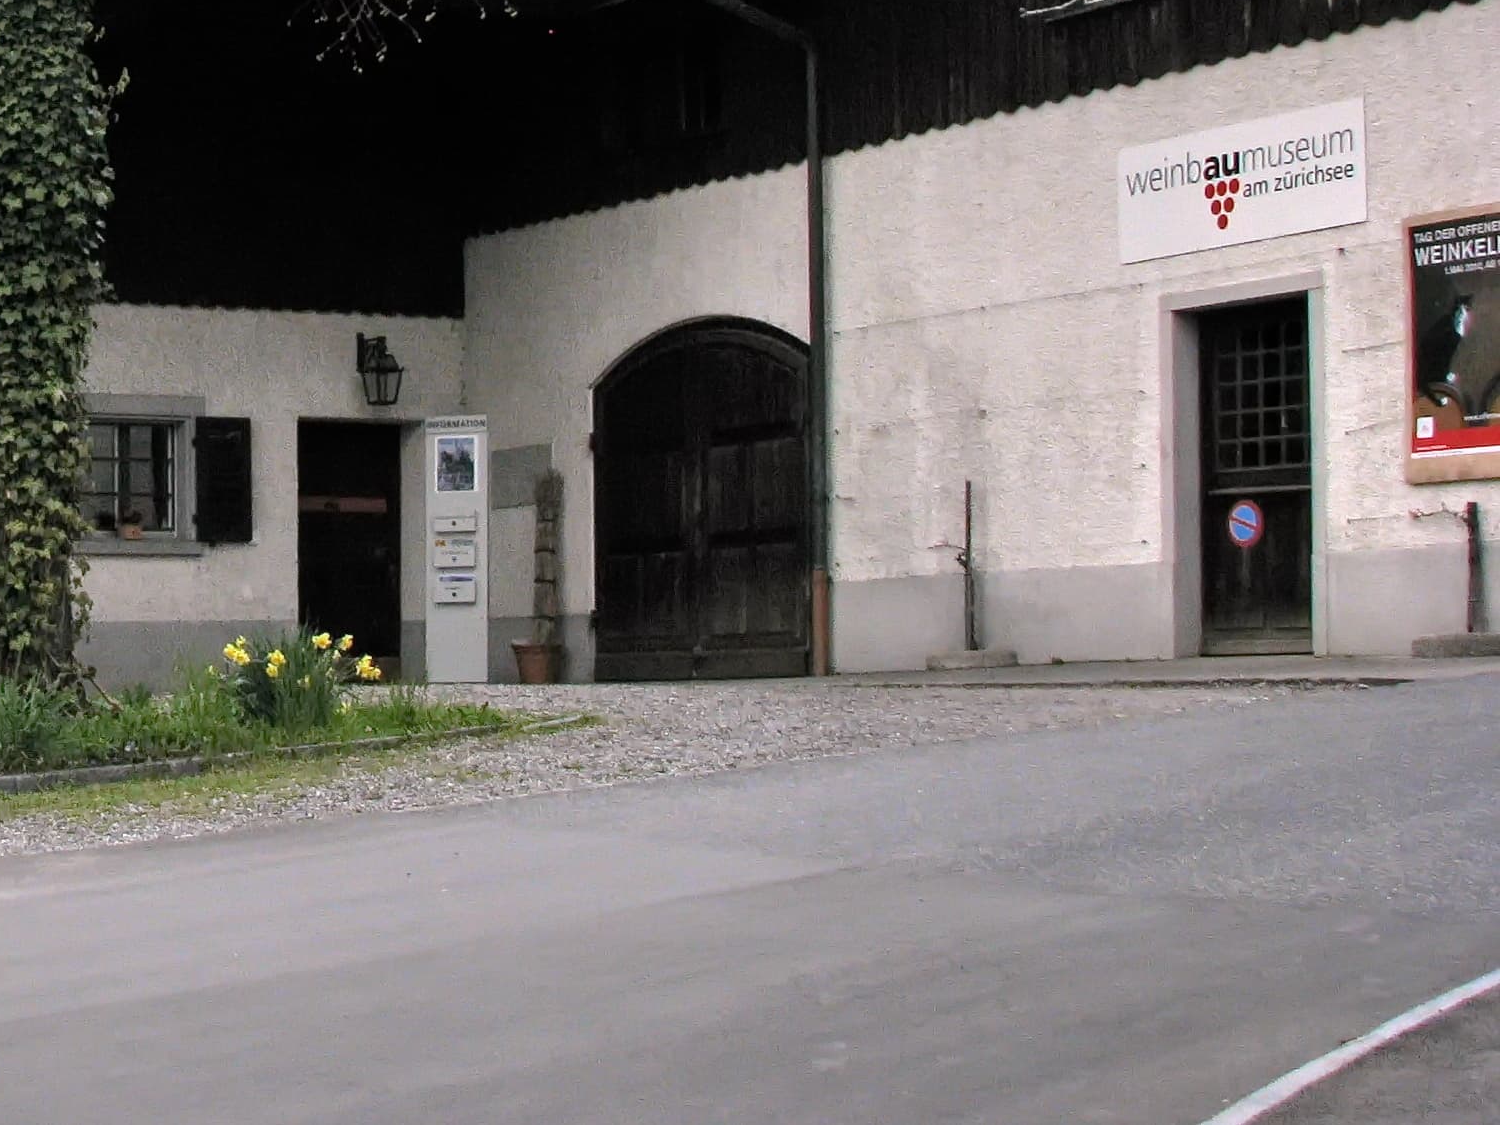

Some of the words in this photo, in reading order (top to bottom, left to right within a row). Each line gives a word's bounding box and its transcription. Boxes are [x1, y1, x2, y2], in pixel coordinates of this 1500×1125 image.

[1126, 128, 1354, 197] weinbaumuseum
[1243, 179, 1268, 198] am
[1274, 162, 1354, 192] zürichsee
[1414, 231, 1433, 243] TAG
[1435, 228, 1456, 241] DER
[1414, 235, 1500, 267] WEINKEL
